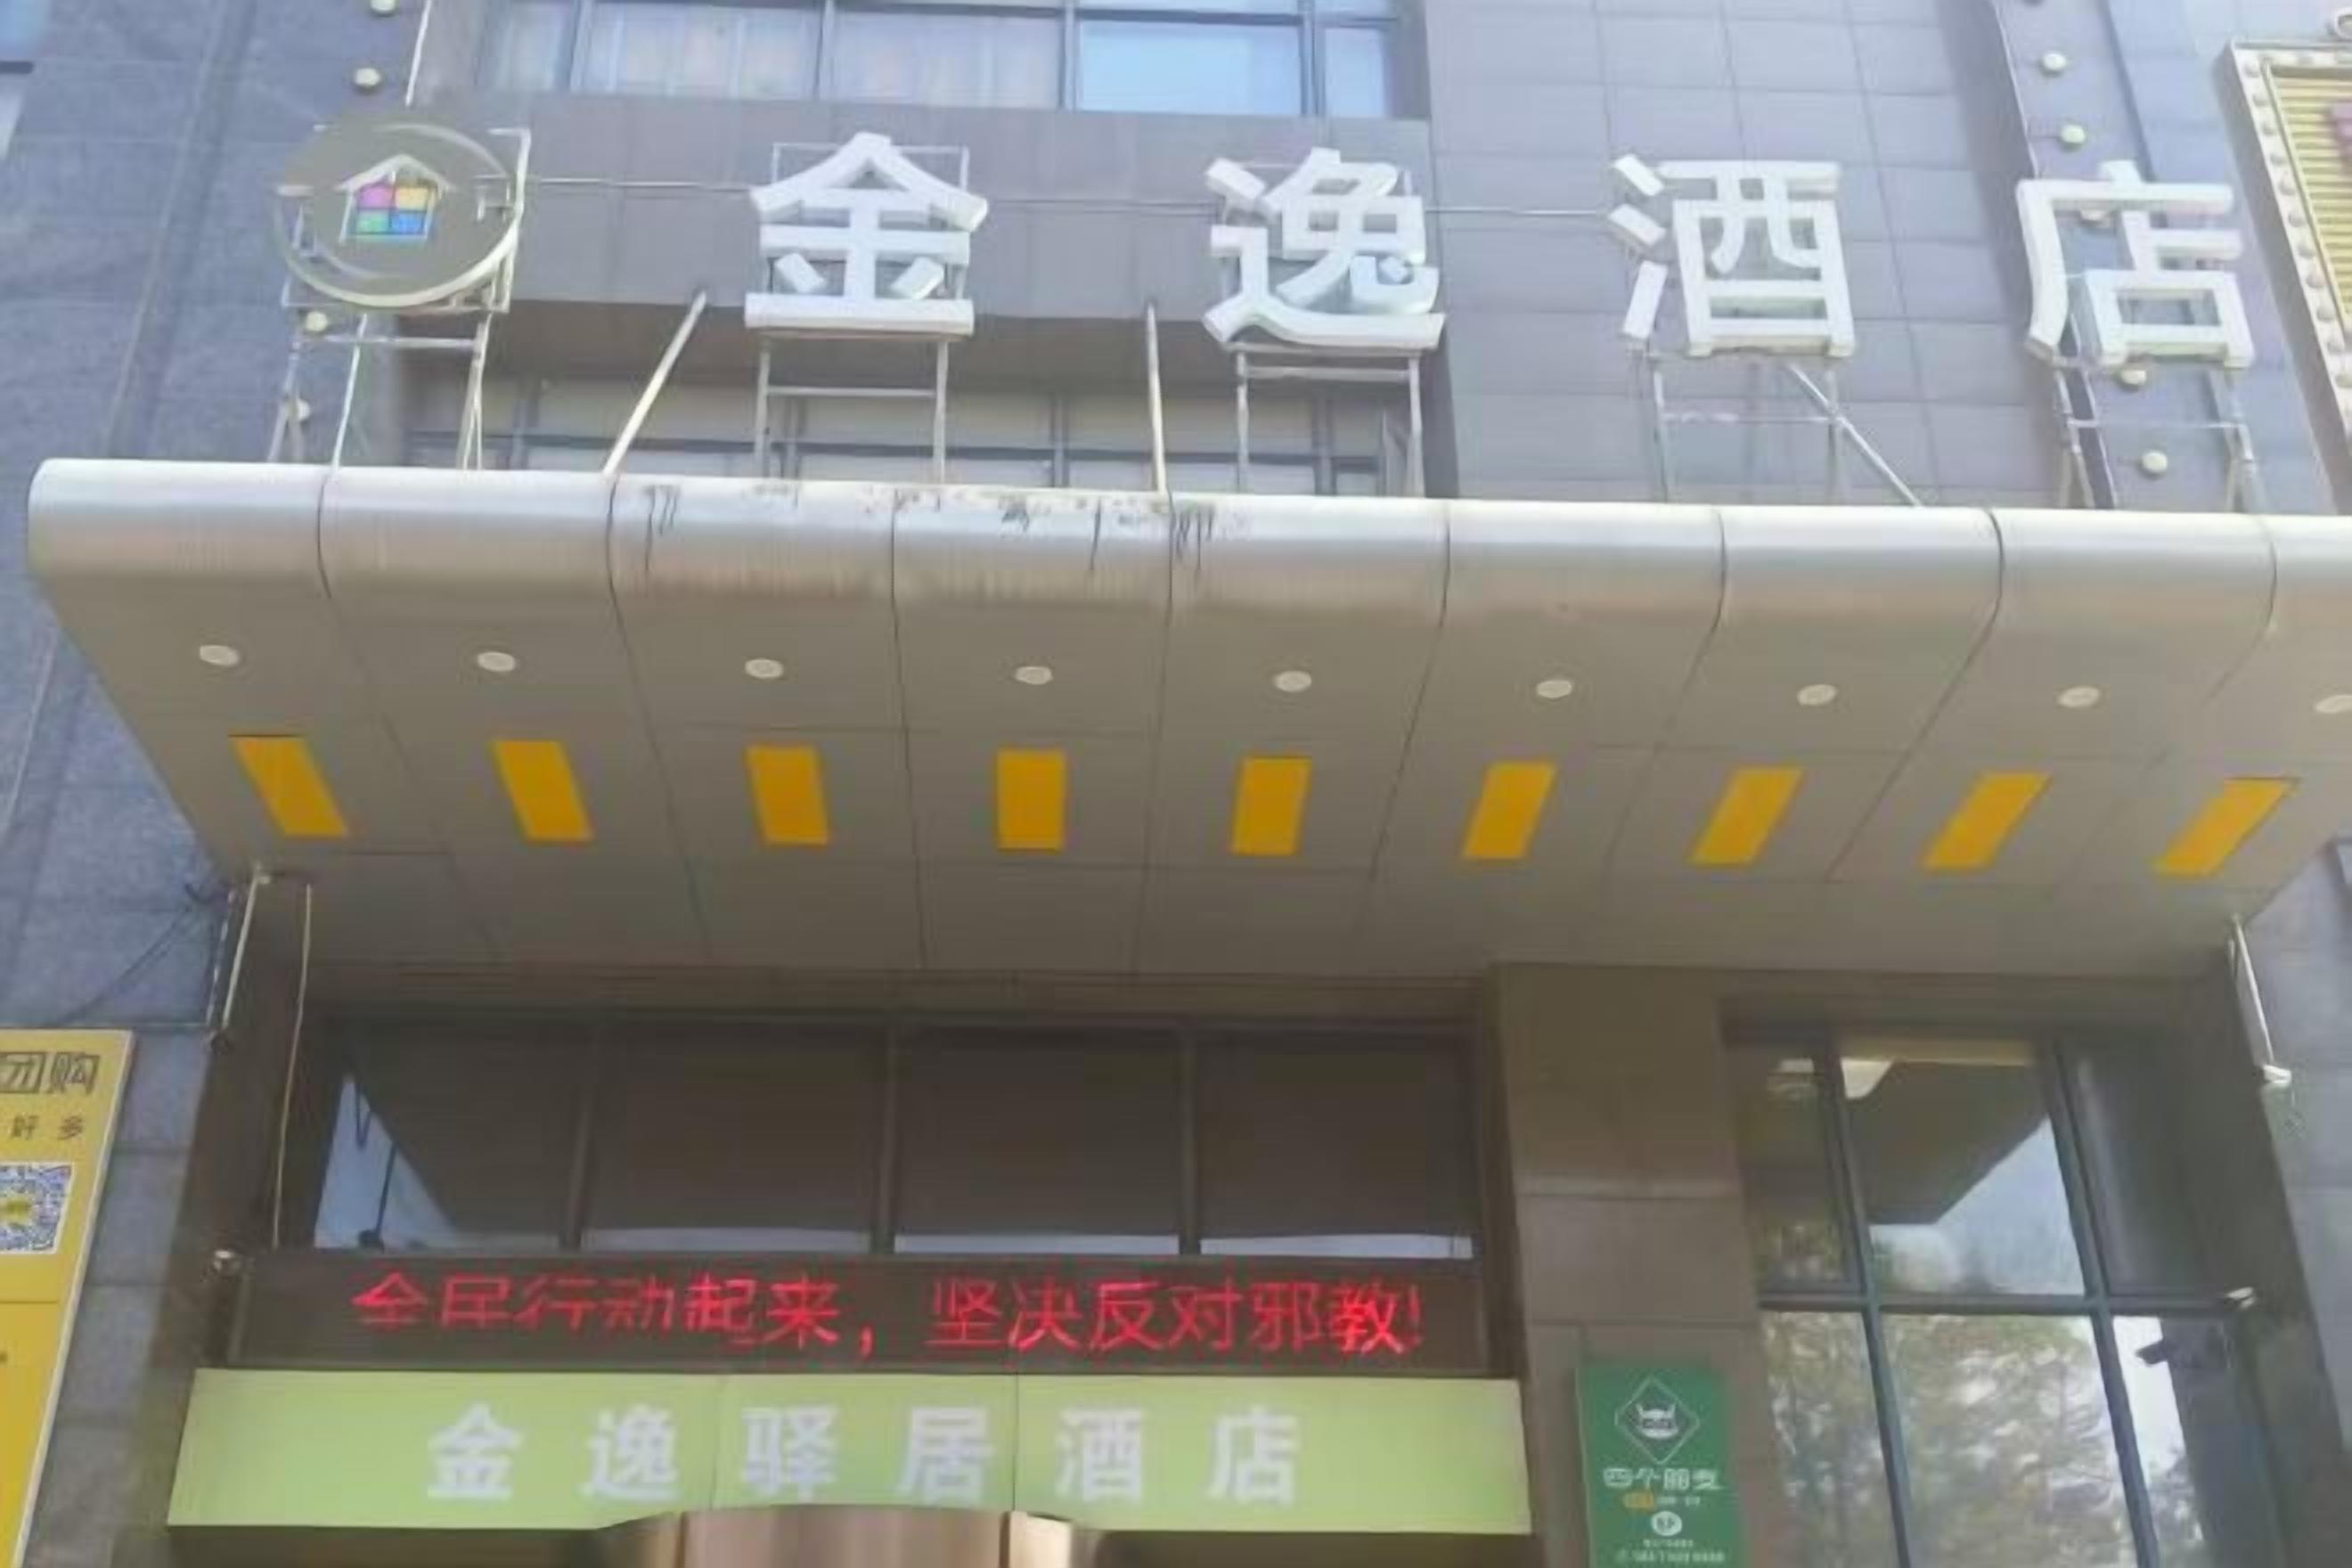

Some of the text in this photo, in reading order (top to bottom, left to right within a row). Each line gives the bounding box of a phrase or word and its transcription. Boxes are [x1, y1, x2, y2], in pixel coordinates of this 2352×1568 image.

[745, 131, 2254, 367] 金逸酒店
[426, 1401, 1301, 1507] 金逸驿居酒店
